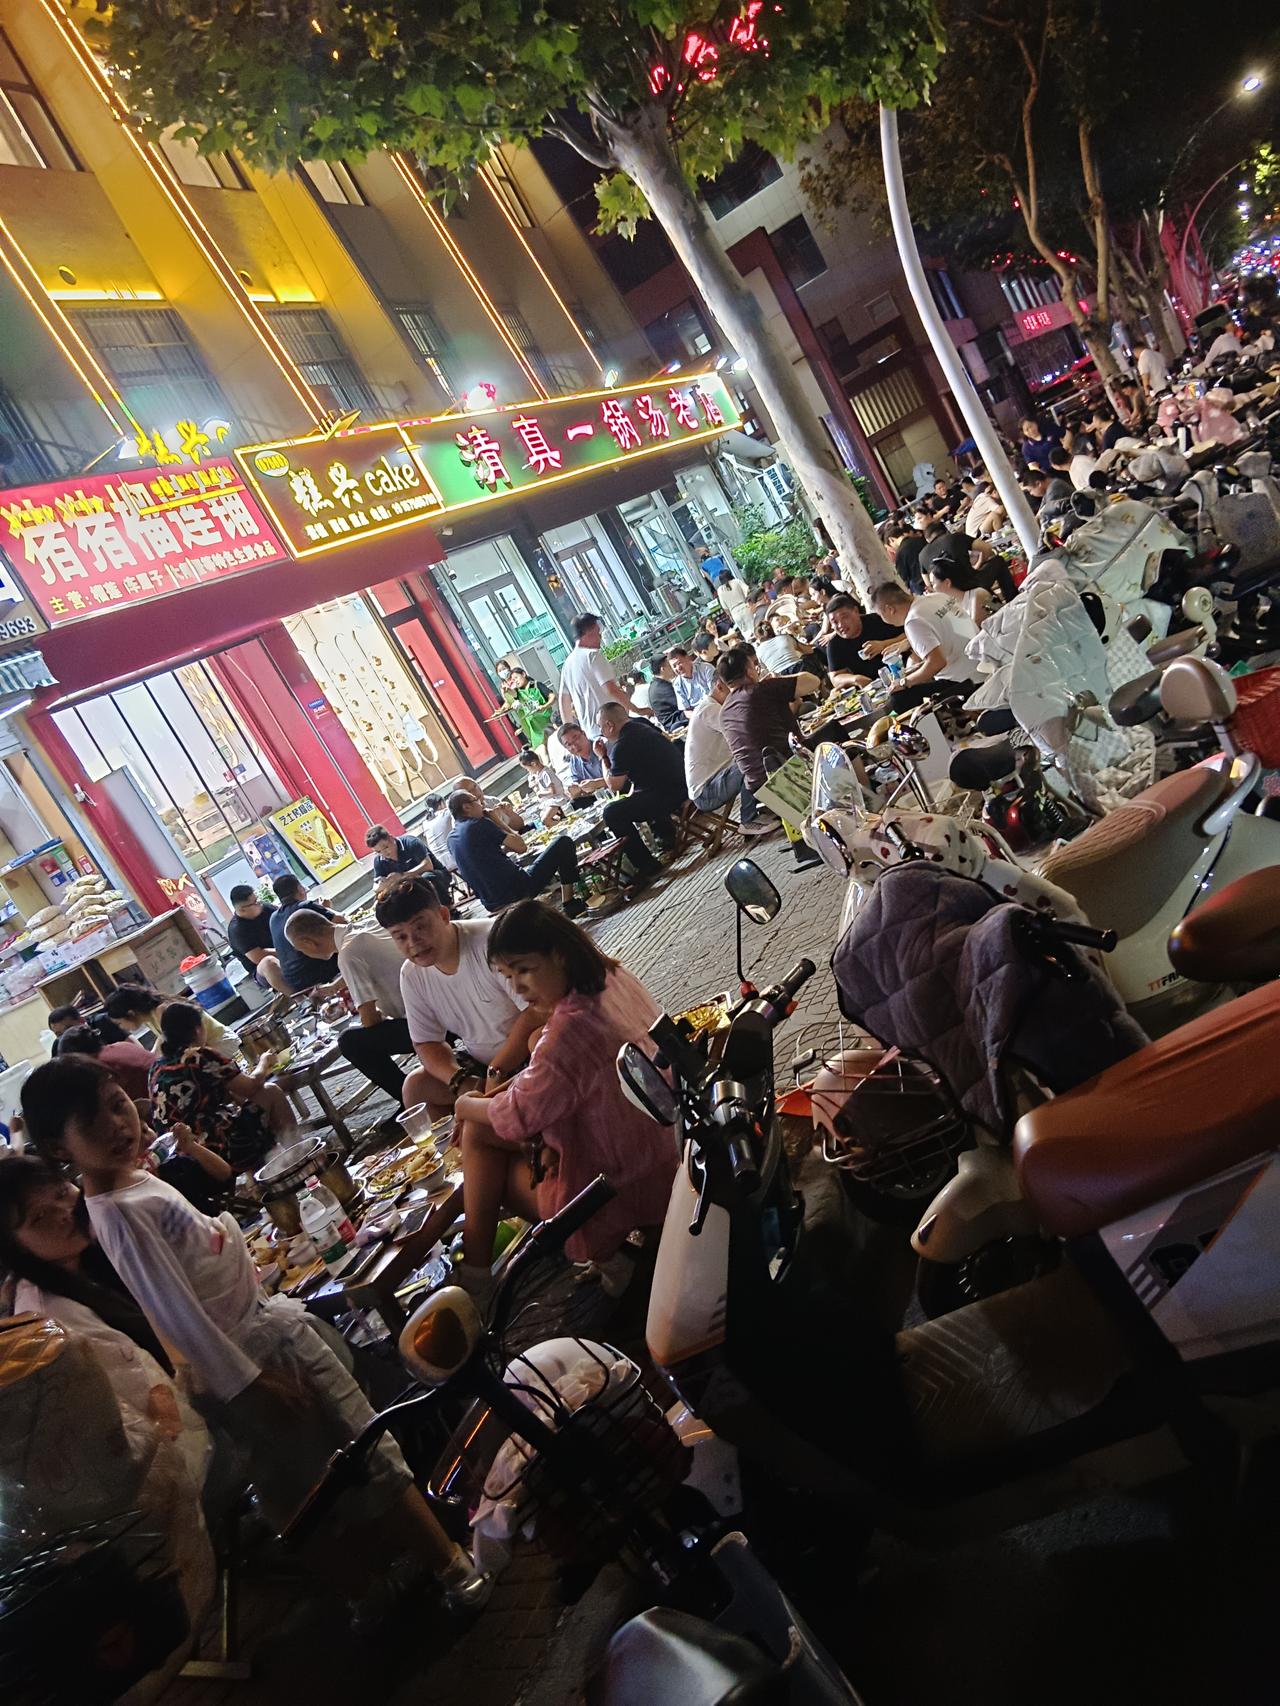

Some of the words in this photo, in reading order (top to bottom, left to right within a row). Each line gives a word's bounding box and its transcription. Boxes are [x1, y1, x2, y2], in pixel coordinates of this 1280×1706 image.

[455, 387, 725, 490] 清真一锅汤老店
[365, 456, 420, 496] cake
